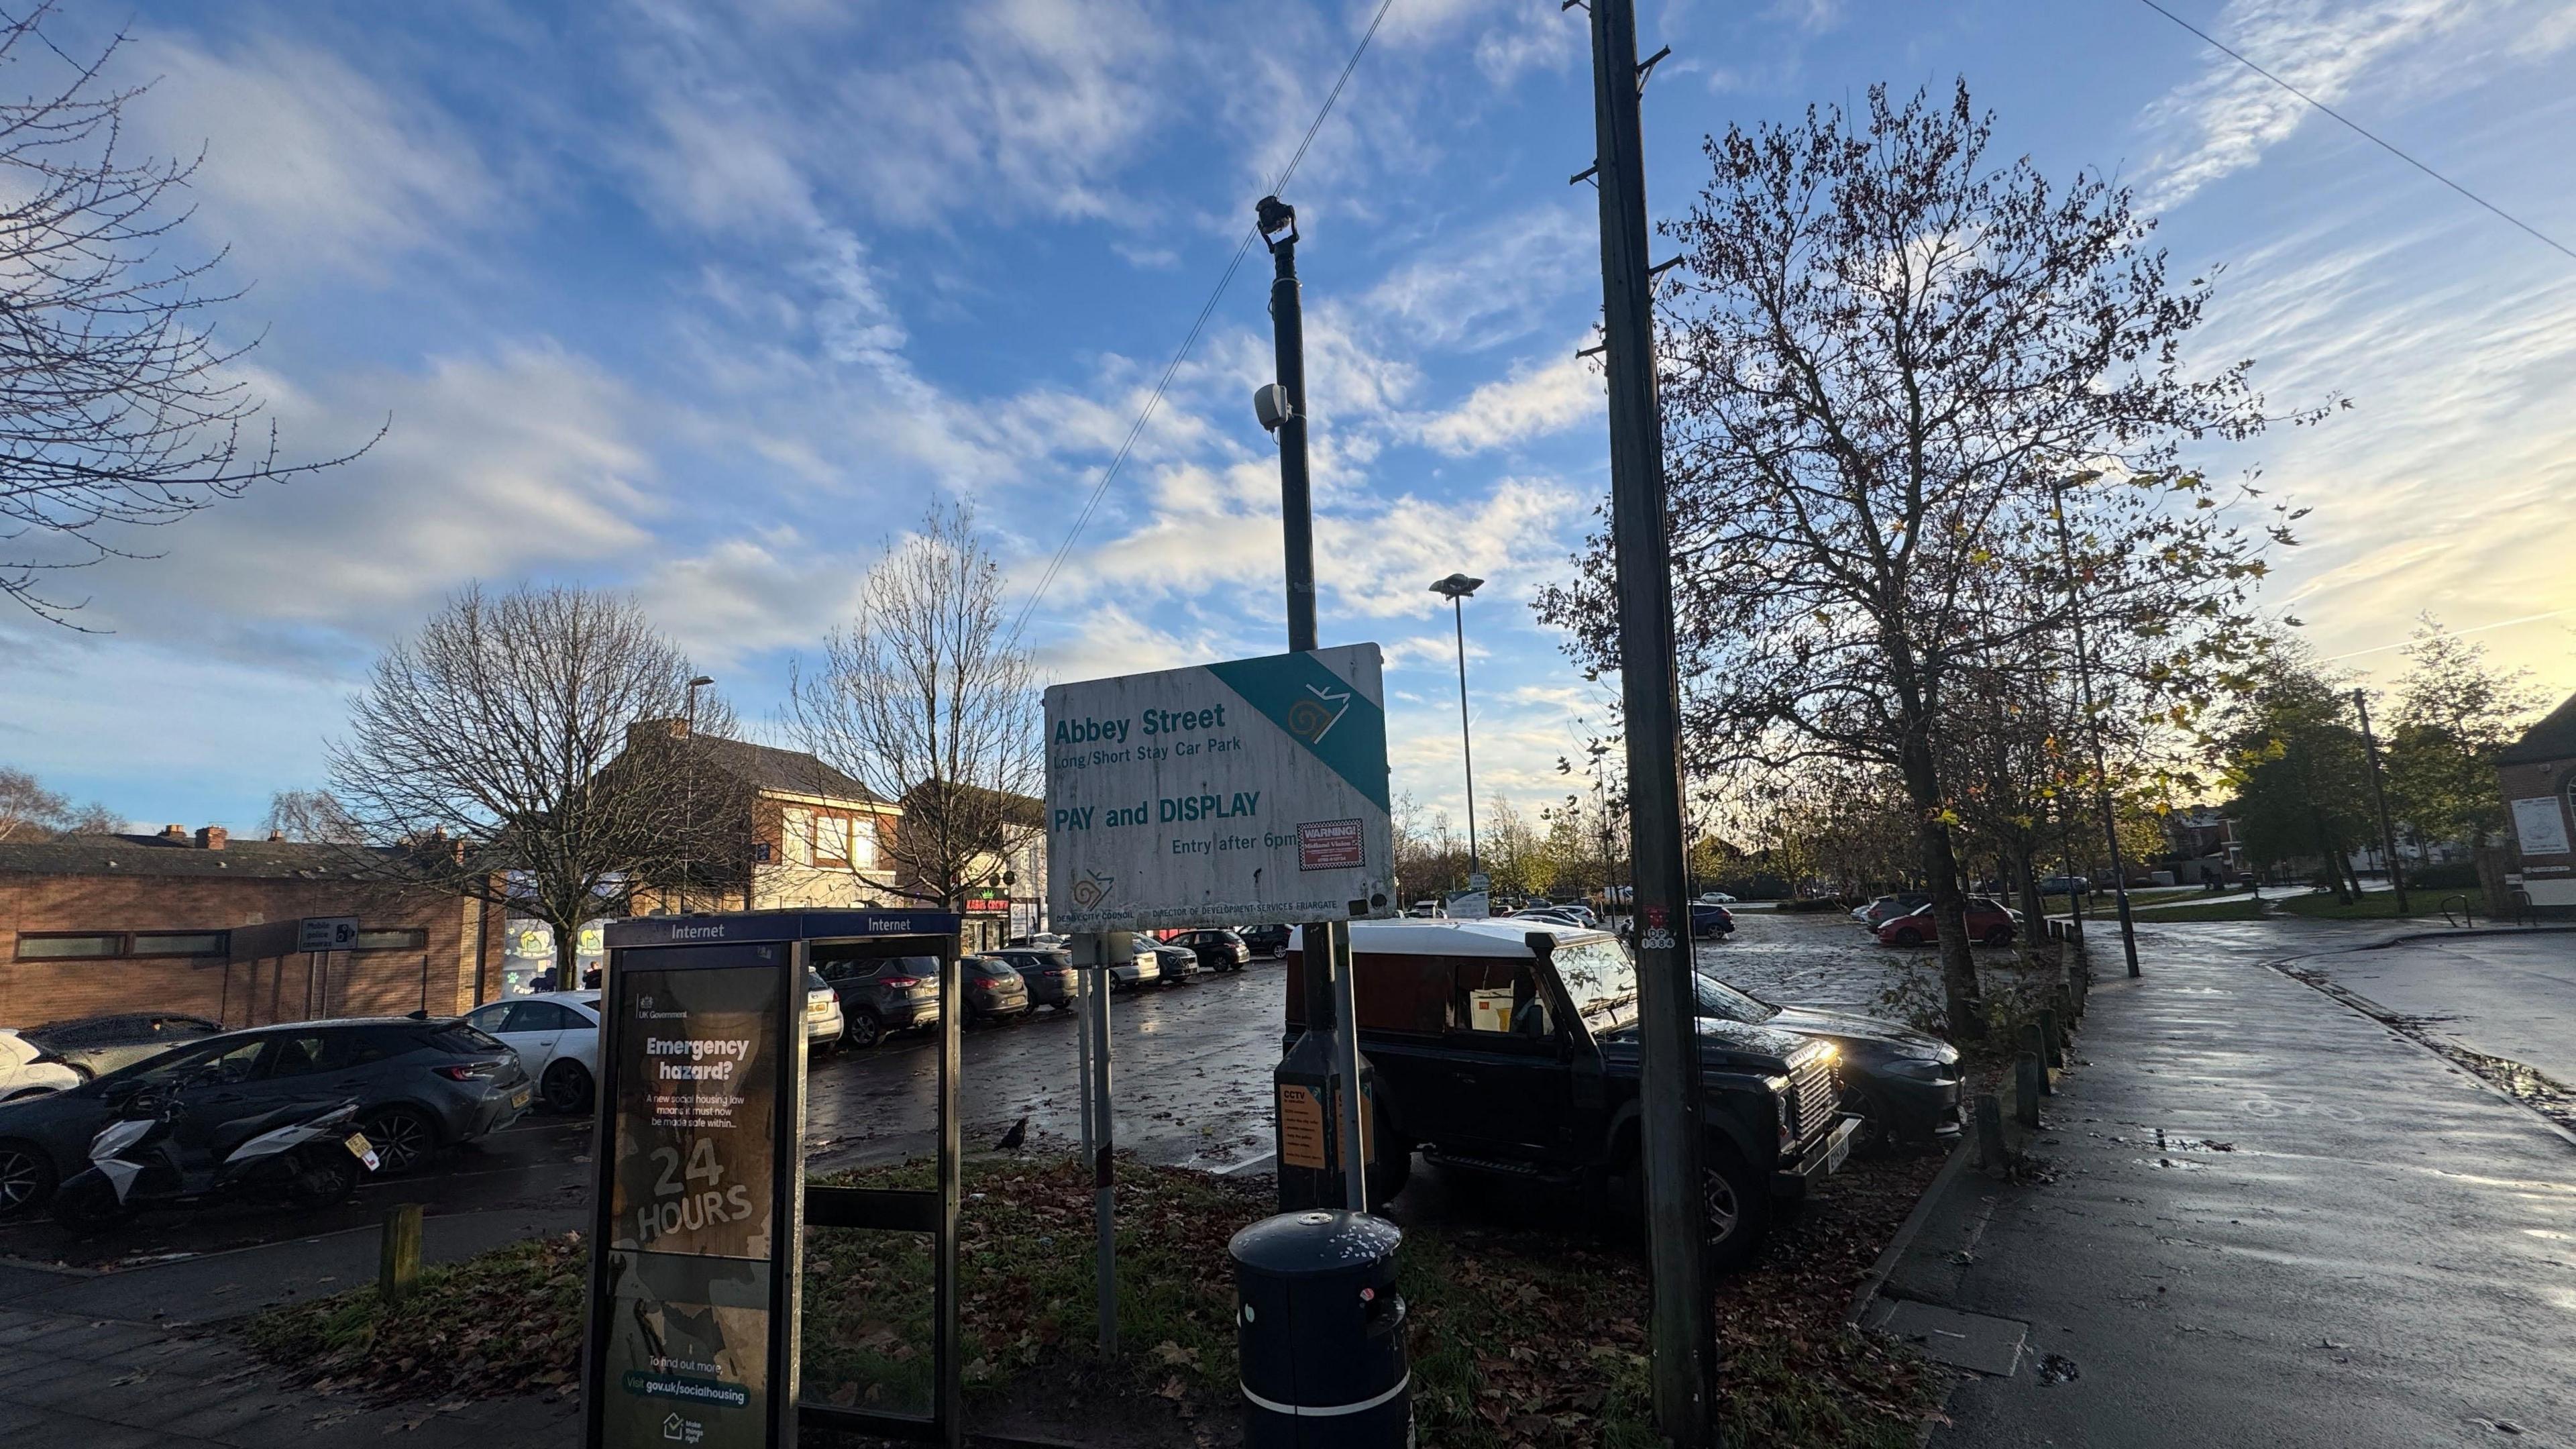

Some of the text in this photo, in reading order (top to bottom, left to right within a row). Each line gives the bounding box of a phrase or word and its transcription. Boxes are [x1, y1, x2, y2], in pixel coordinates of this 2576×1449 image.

[1054, 704, 1226, 745] Abbey Street
[1053, 736, 1241, 769] Long/Short Stay Car Park
[1055, 791, 1260, 833] PAY and DISPLAY
[1304, 826, 1356, 839] WARNING!
[1172, 832, 1297, 855] Entry after 6pm
[1152, 900, 1337, 918] DIRECTOR OF DEVELOPMENT SERVICES FRIARGATE
[1057, 913, 1081, 922] DERBY
[1102, 911, 1134, 920] COUNCIL
[868, 918, 911, 931] Internet
[672, 924, 724, 939] Internet
[1649, 929, 1666, 937] DP
[1643, 939, 1674, 947] 1384
[649, 1010, 688, 1018] Government
[647, 1038, 749, 1061] Emergency
[659, 1061, 733, 1080] hazard?
[647, 1094, 652, 1103] A
[672, 1094, 694, 1104] social
[696, 1094, 728, 1106] housing
[729, 1095, 745, 1104] law
[1284, 1090, 1305, 1100] CCTV
[685, 1107, 691, 1115] it
[692, 1107, 714, 1116] must
[651, 1117, 662, 1126] be
[663, 1118, 687, 1126] made
[688, 1118, 706, 1127] safe
[650, 1137, 724, 1196] 24
[637, 1185, 753, 1240] HOURS
[649, 1355, 723, 1375] To find out more,
[627, 1376, 745, 1405] Visit gov.uk/socialhousing
[686, 1420, 702, 1428] Make
[685, 1428, 704, 1437] things
[685, 1435, 700, 1444] right
